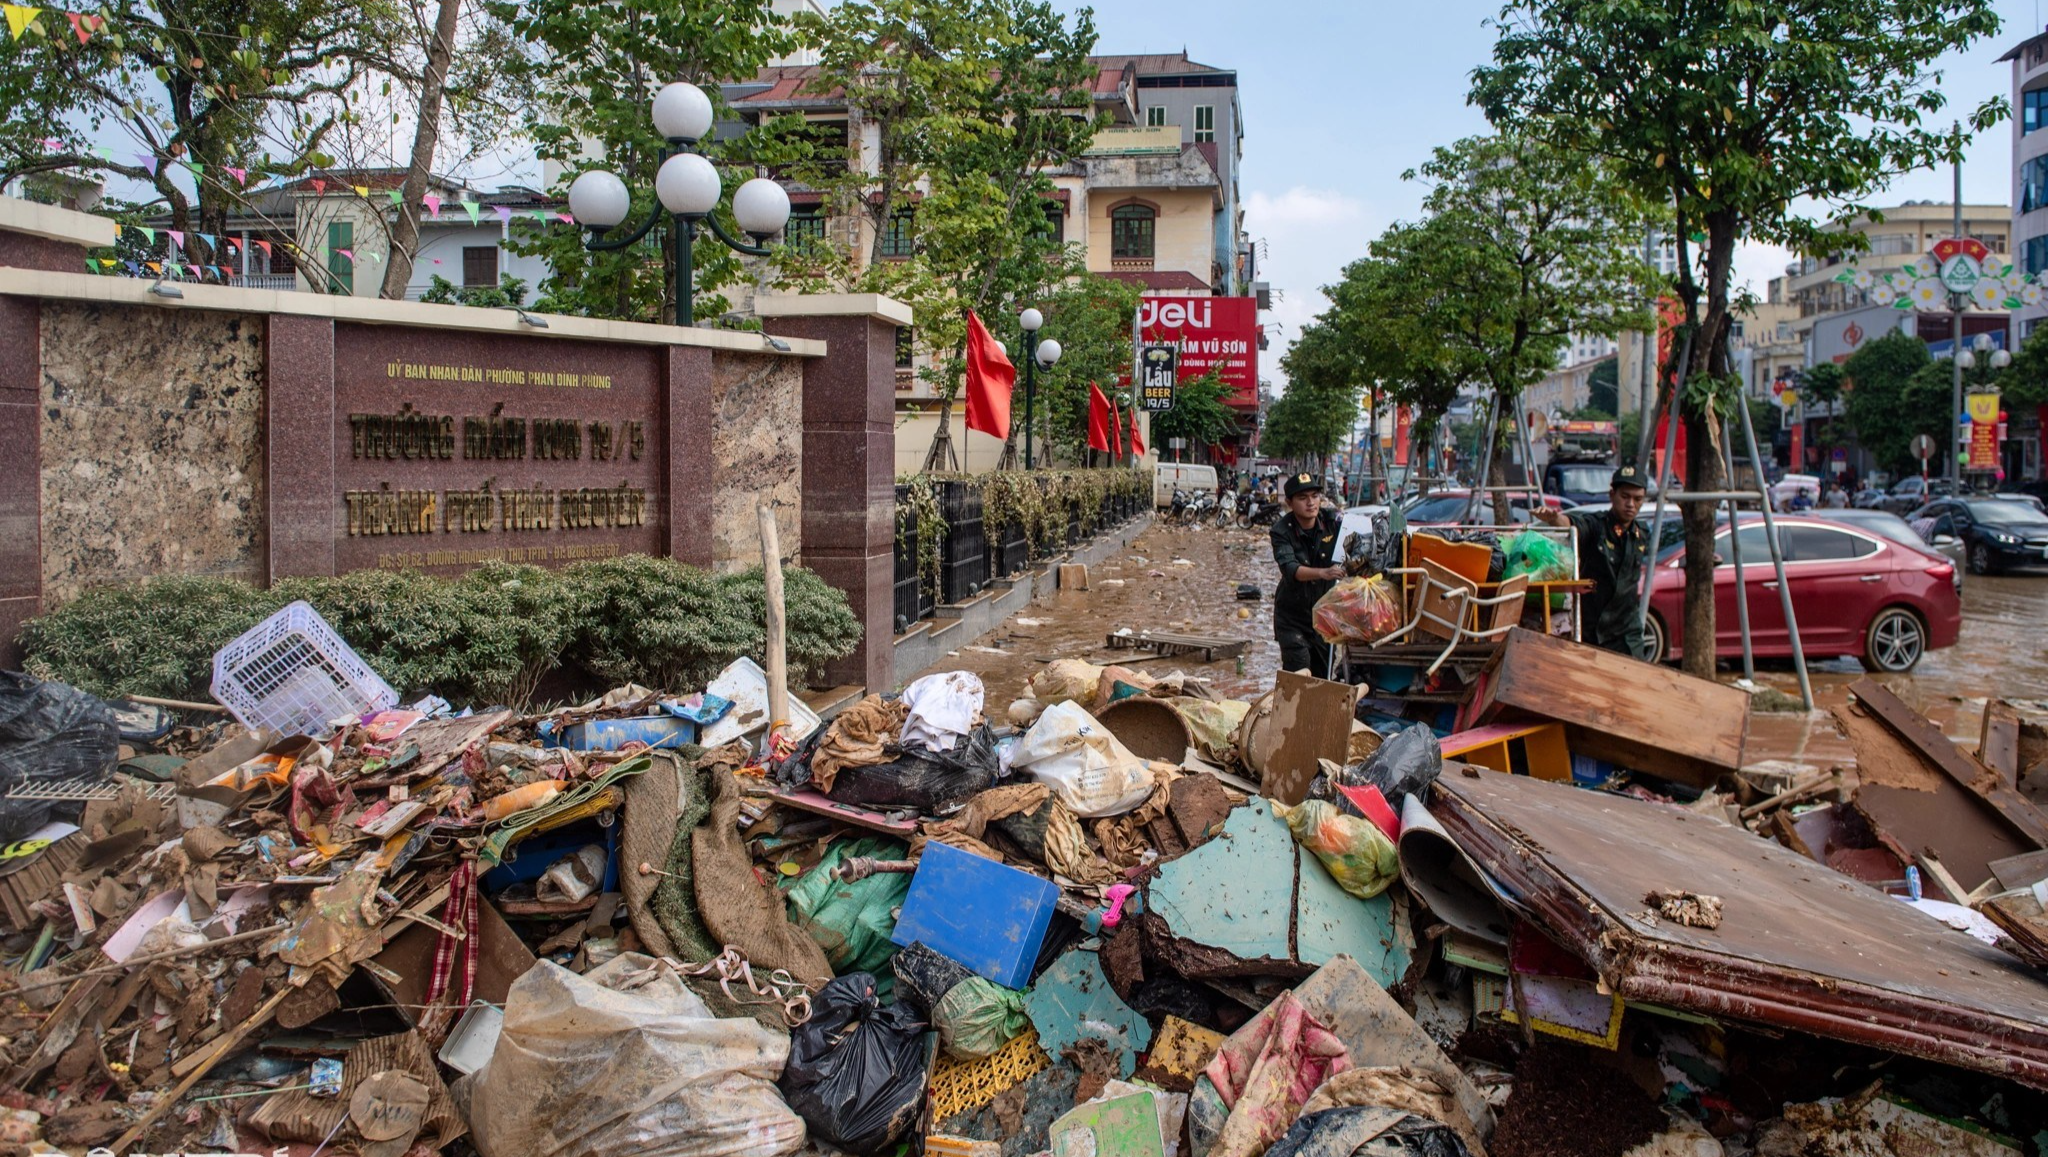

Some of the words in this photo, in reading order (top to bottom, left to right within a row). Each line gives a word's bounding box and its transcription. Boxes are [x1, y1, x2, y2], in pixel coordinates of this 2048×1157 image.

[1202, 337, 1220, 354] VŨ
[1222, 339, 1247, 354] SƠN
[404, 364, 427, 379] BAN
[429, 363, 459, 381] NHÂN
[461, 365, 483, 382] DÂN
[485, 366, 525, 385] PHƯỜNG
[528, 371, 554, 386] PHAN
[556, 370, 579, 387] ĐÌNH
[581, 372, 612, 389] PHÙNG
[1145, 362, 1172, 387] Lẩu
[1145, 388, 1171, 398] BEER
[1146, 398, 1170, 408] 19/5
[350, 402, 456, 460] TRƯỜNG
[532, 417, 583, 461] NON
[587, 418, 646, 461] 19/5
[345, 481, 438, 536] THÀNH
[446, 475, 497, 533] PHỐ
[501, 481, 554, 532] THÁI
[560, 480, 647, 529] NGUYÊN
